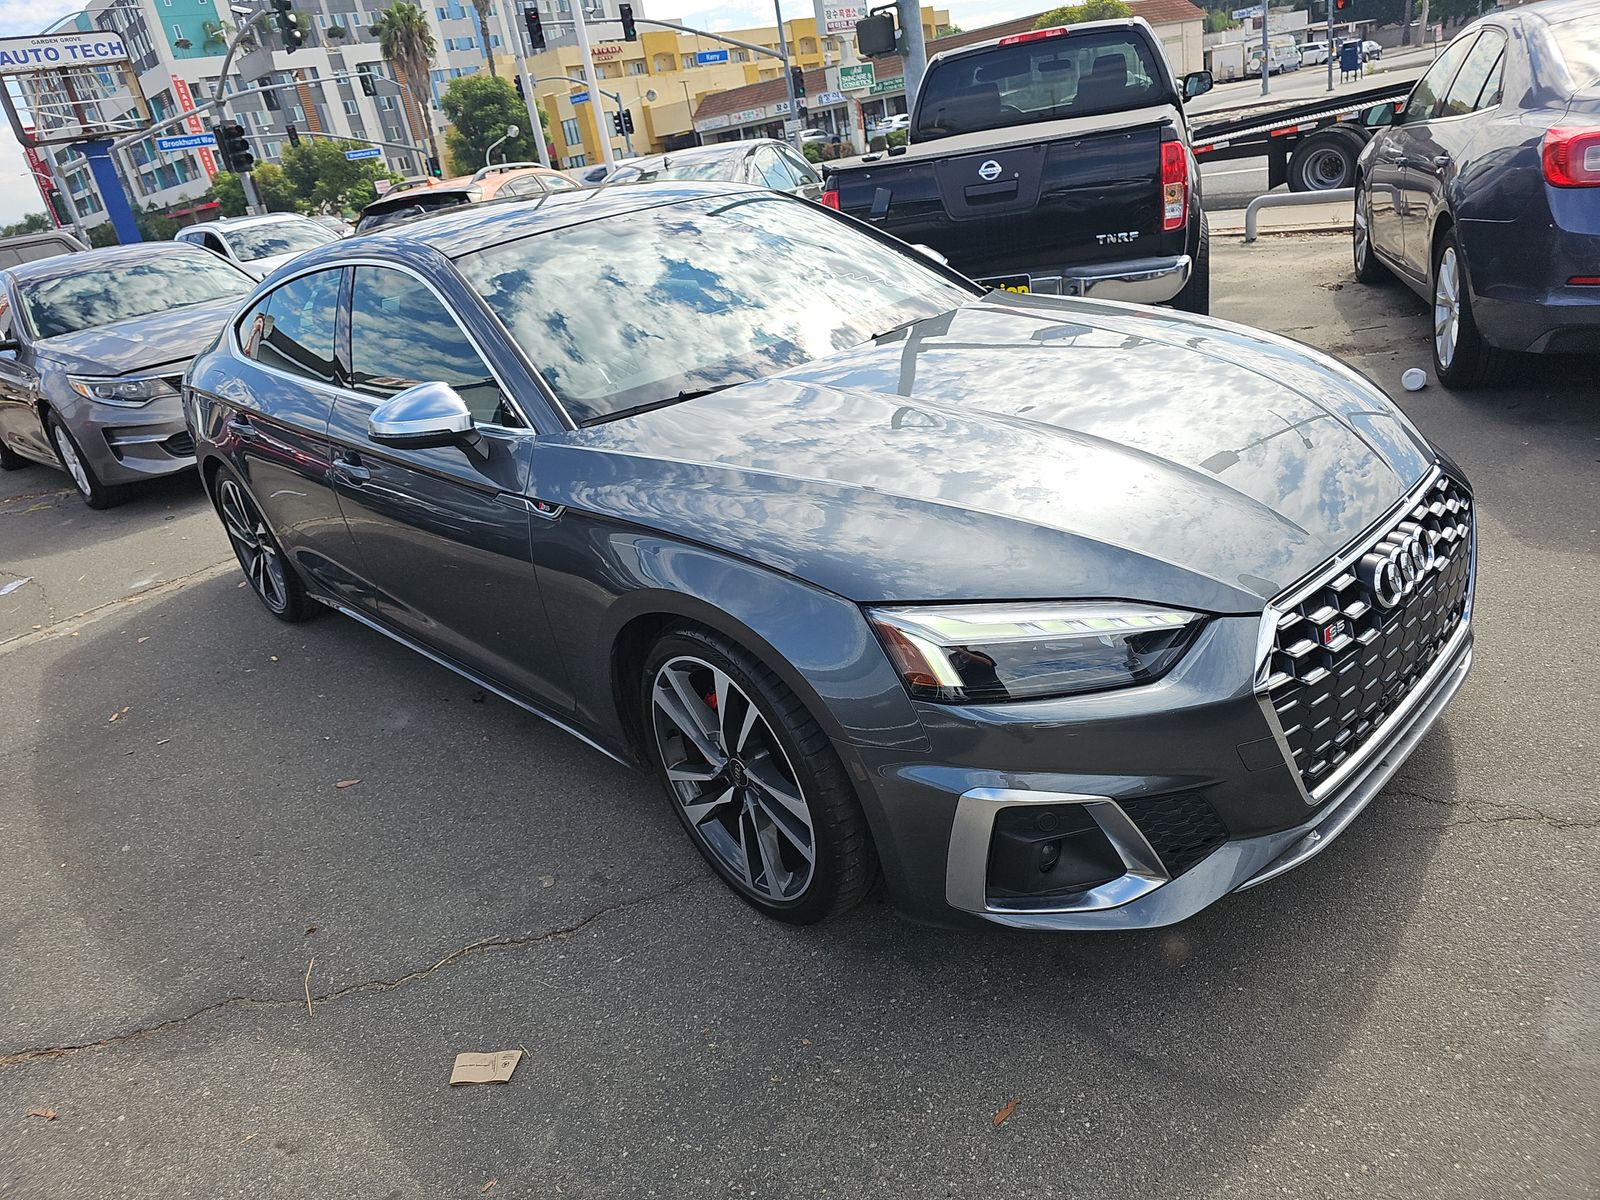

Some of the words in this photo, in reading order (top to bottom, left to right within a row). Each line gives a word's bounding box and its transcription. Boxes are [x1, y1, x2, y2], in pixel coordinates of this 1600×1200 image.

[0, 47, 60, 65] AUTO
[65, 41, 125, 59] TECH
[162, 137, 201, 148] Brookhurst
[201, 135, 216, 144] Way
[1096, 231, 1139, 245] TNRF
